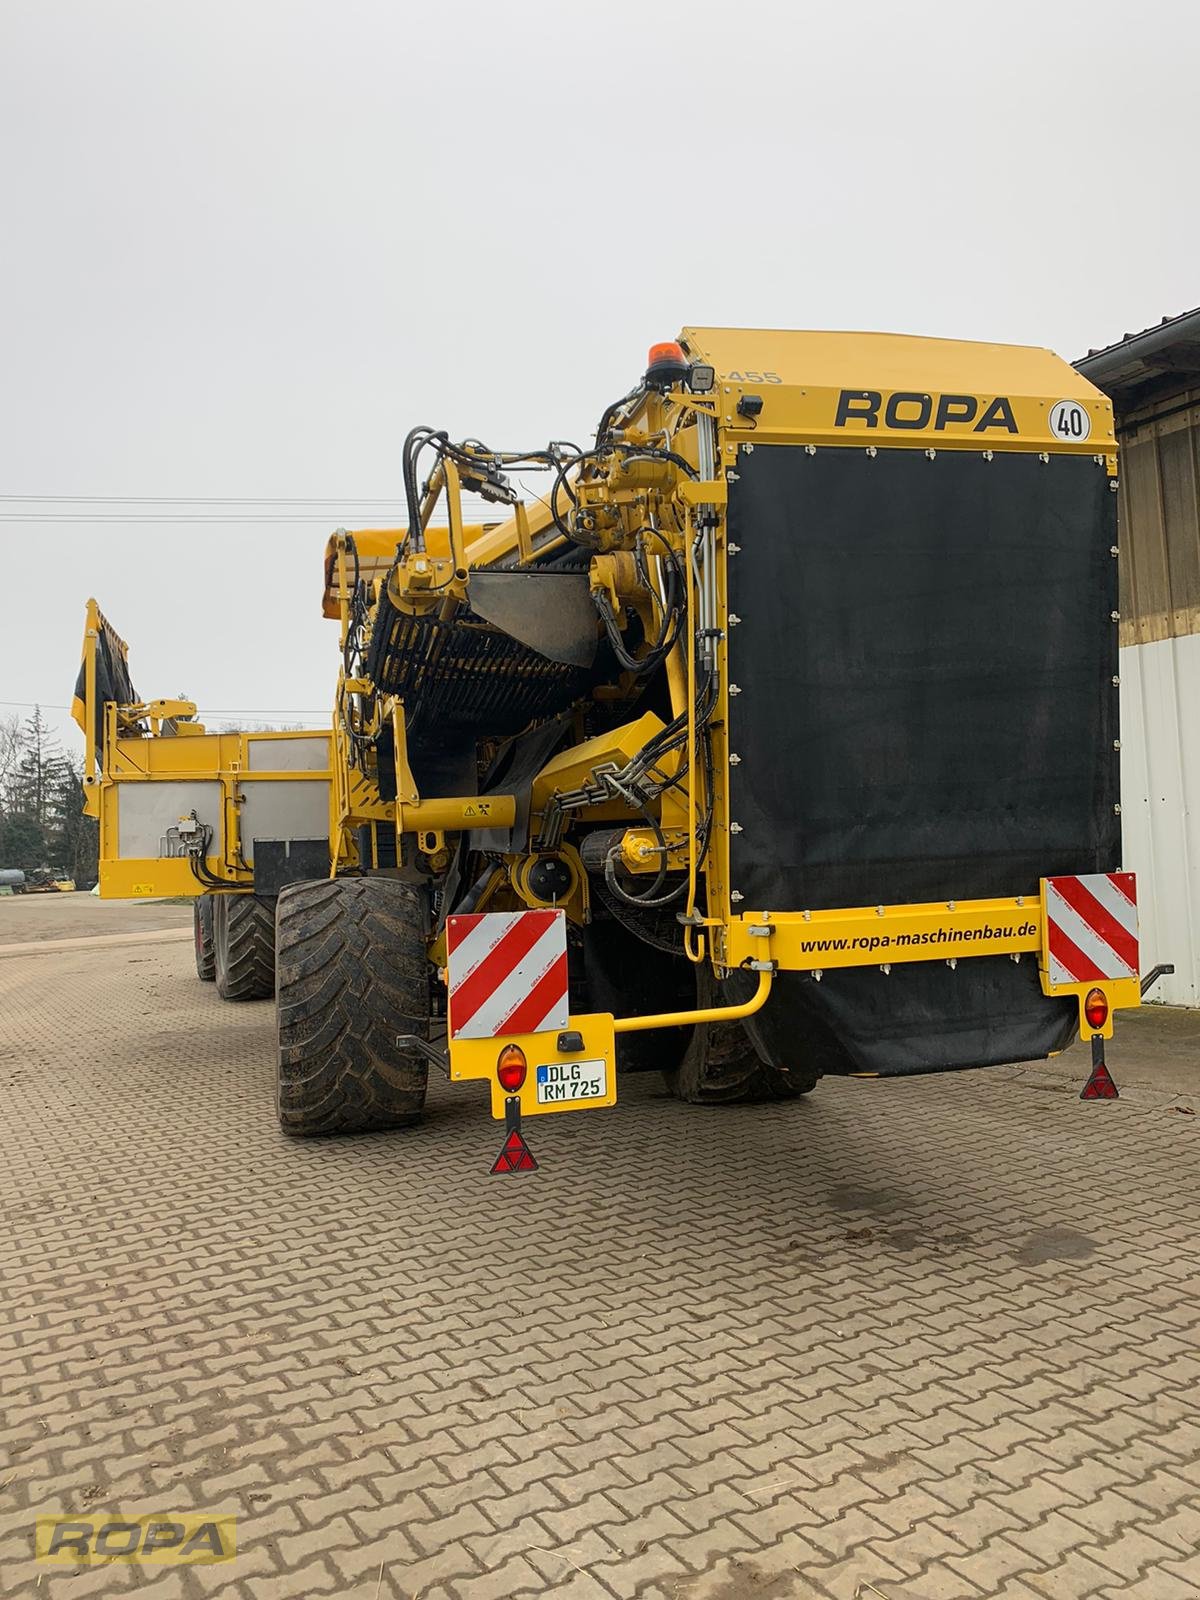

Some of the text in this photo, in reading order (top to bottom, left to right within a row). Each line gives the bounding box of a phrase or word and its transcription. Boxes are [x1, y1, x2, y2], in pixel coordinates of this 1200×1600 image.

[729, 371, 783, 384] 455
[834, 389, 1020, 434] ROPA
[1057, 407, 1083, 437] 40
[800, 922, 1038, 953] www.ropa-maschinenbau.de
[549, 1065, 580, 1082] DLG
[544, 1079, 600, 1100] RM 725
